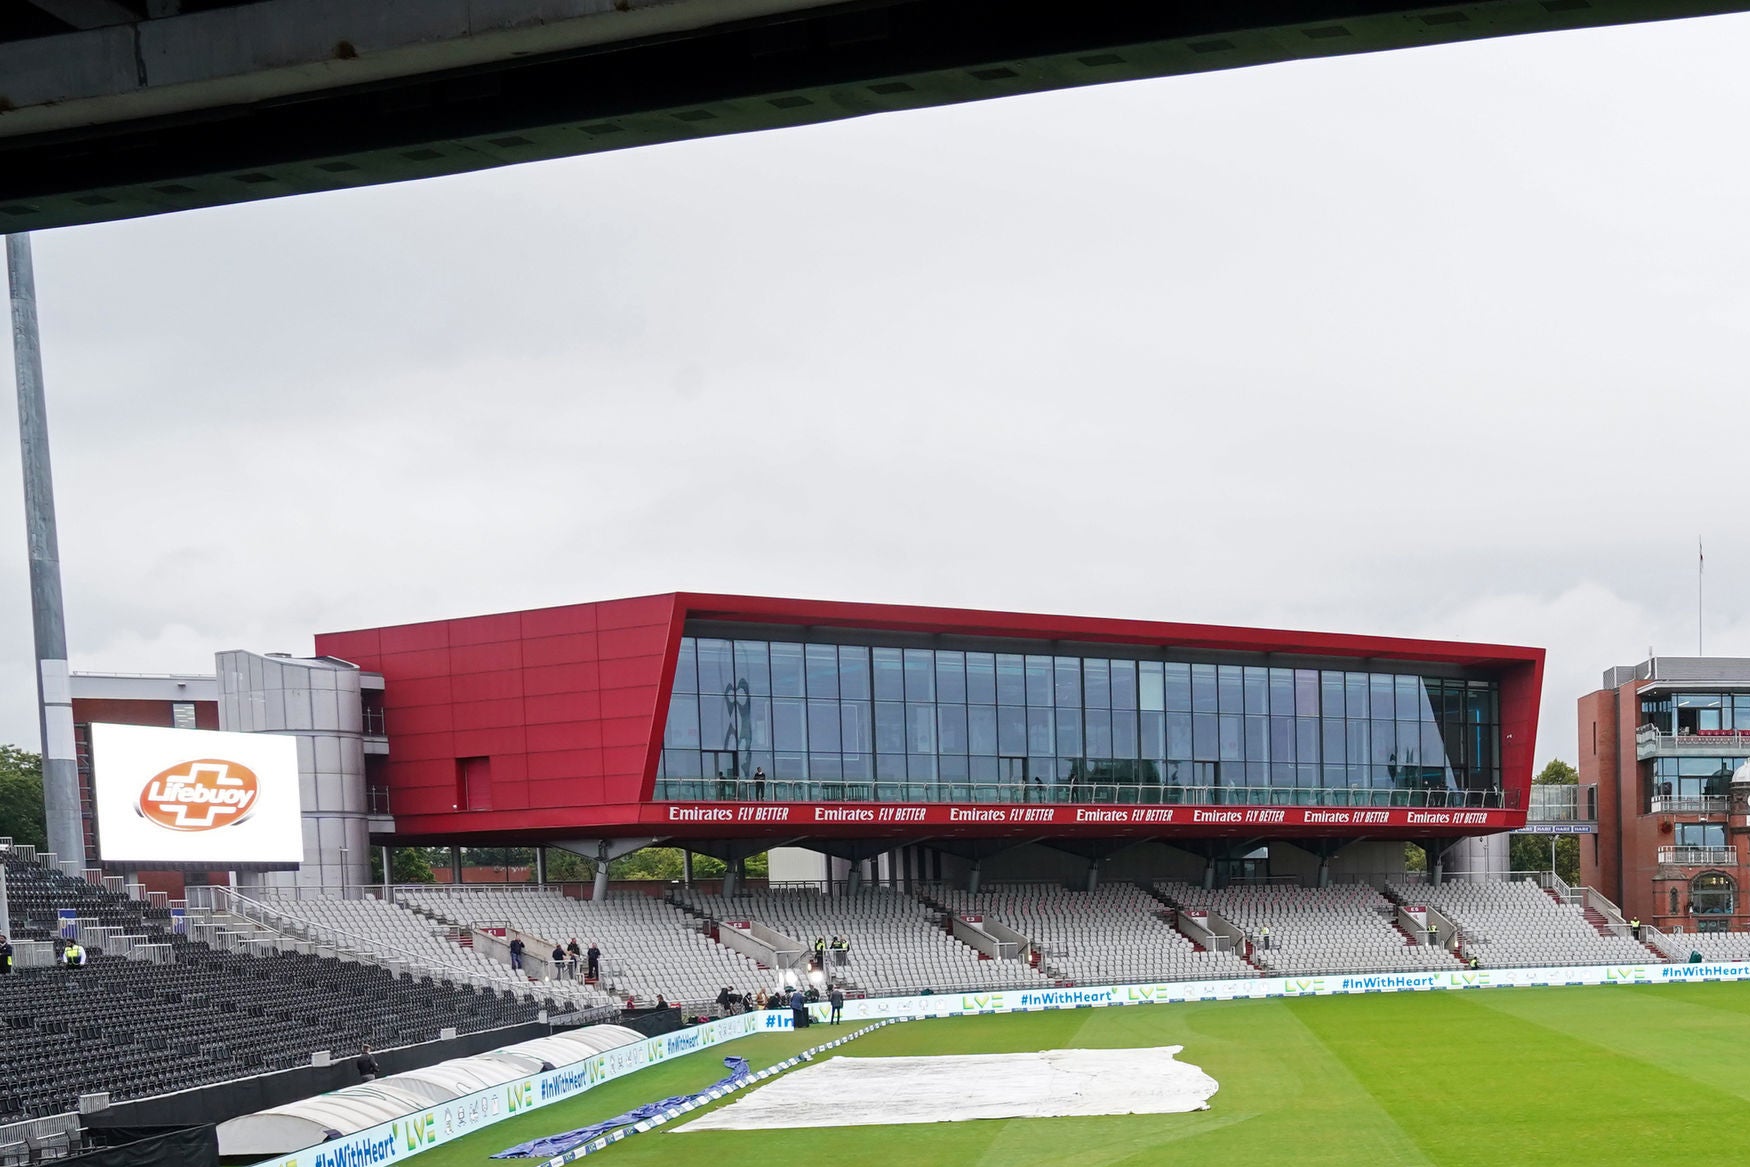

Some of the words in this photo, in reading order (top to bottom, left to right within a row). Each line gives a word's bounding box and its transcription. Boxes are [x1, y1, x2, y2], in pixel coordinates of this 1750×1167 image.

[148, 782, 254, 808] Lifebuoy
[669, 806, 732, 820] Emirates
[738, 807, 754, 820] FLY
[755, 807, 789, 820] BETTER
[815, 808, 874, 820] Emirates
[878, 808, 894, 820] FLY
[895, 808, 926, 820] BETTER
[950, 808, 1005, 821] Emirates
[1010, 808, 1024, 821] FLY
[1025, 808, 1054, 821] BETTER
[1076, 808, 1128, 821] Emirates
[1132, 809, 1145, 822] FLY
[1146, 809, 1173, 822] BETTER
[1193, 810, 1242, 822] Emirates
[1245, 810, 1259, 822] FLY
[1259, 810, 1284, 822] BETTER
[1304, 810, 1349, 823] Emirates
[1352, 811, 1364, 822] FLY
[1365, 811, 1389, 822] BETTER
[1407, 812, 1449, 823] Emirates
[1452, 812, 1464, 824] FLY
[1464, 812, 1487, 824] BETTER
[1662, 966, 1750, 977] #InWithHeart
[1342, 977, 1434, 989] #InWithHeart
[1021, 991, 1112, 1006] #InWithHeart
[541, 1071, 586, 1100] #InWithHeart
